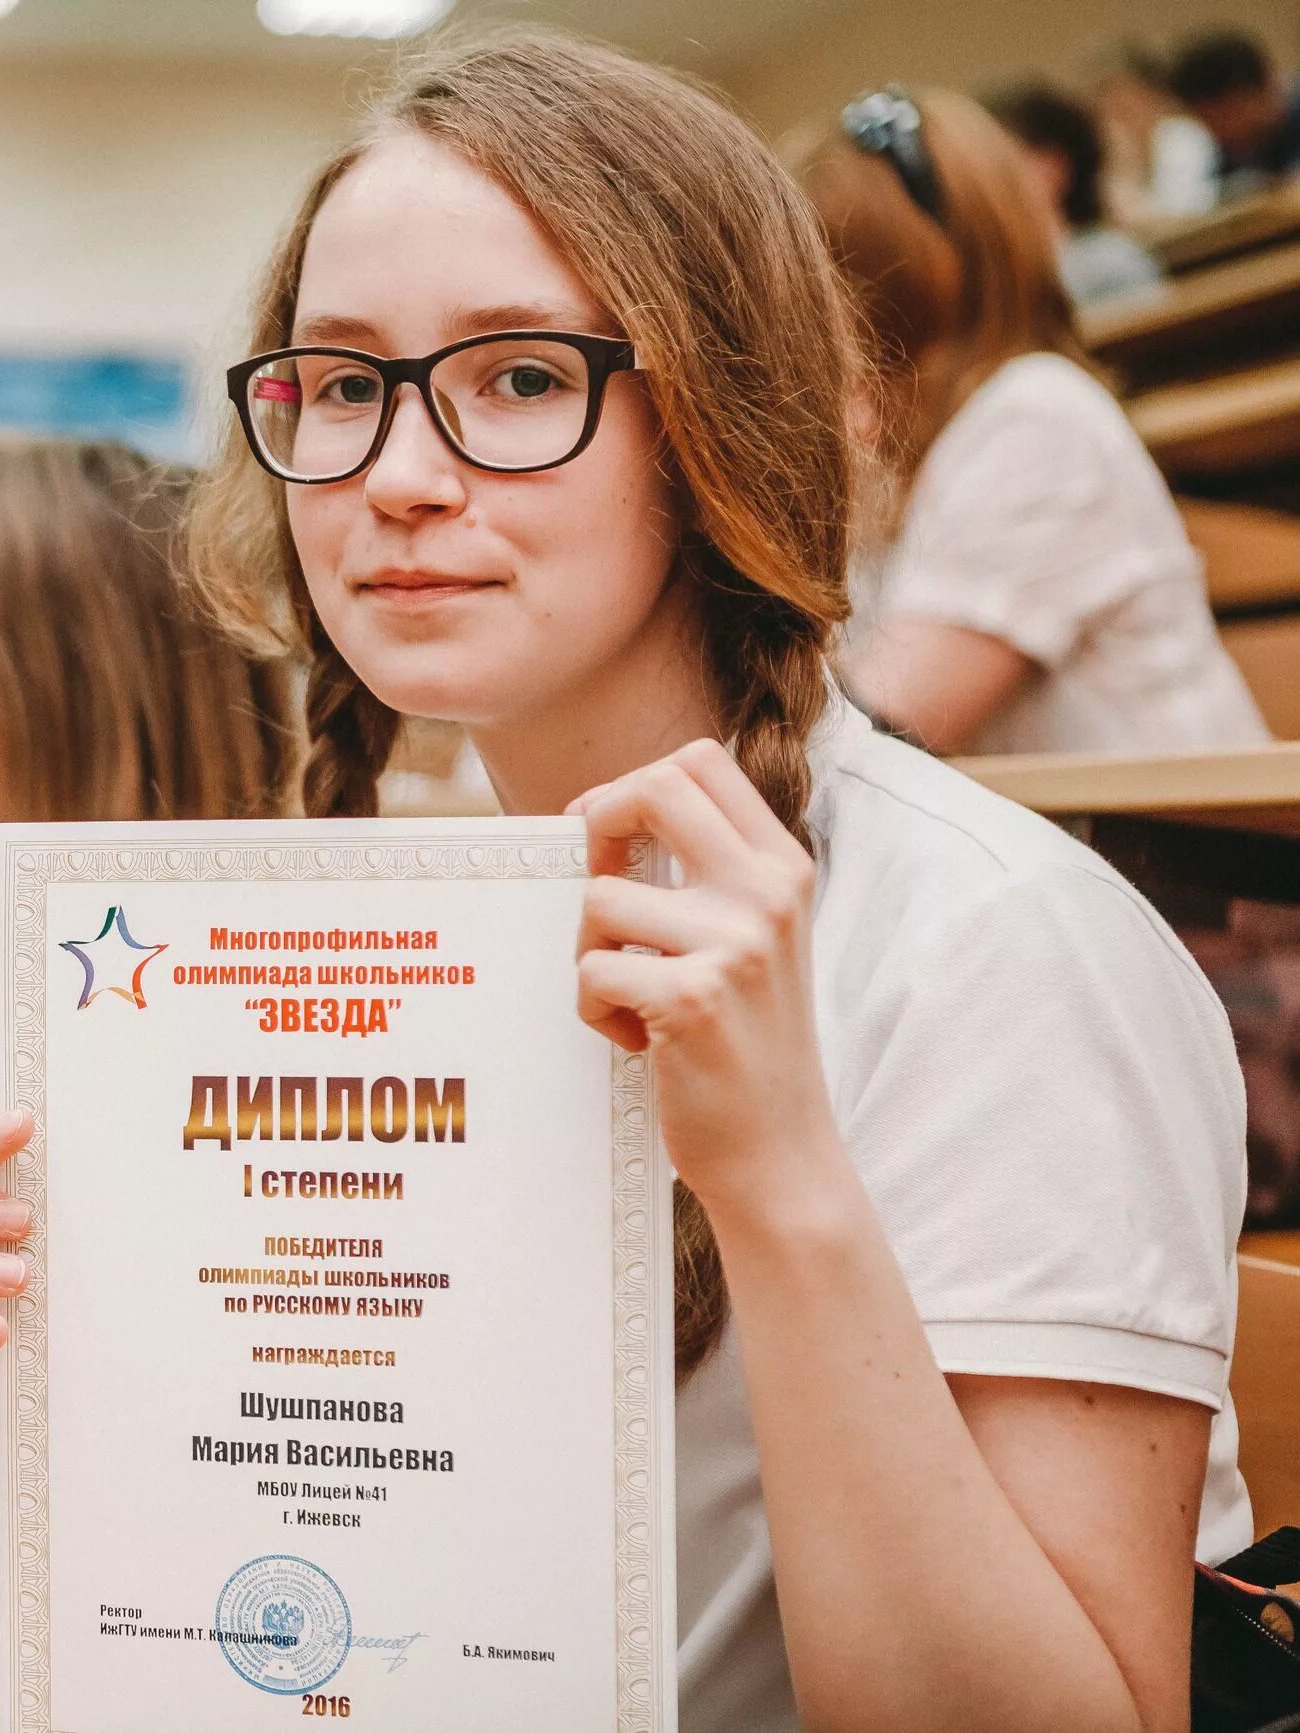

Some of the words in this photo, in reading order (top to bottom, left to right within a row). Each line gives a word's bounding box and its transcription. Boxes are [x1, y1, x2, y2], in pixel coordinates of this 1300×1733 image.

[210, 928, 437, 952] Многопрофильная
[173, 965, 312, 988] олимпиада
[318, 965, 476, 986] школьников
[183, 1076, 466, 1151] ДИПЛОМ
[244, 1164, 252, 1197] I
[261, 1170, 404, 1200] степени
[264, 1237, 383, 1259] ПОБЕДИТЕЛЯ
[199, 1267, 318, 1288] олимпиады
[324, 1270, 450, 1289] школьников
[224, 1297, 247, 1313] по
[253, 1294, 350, 1316] РУССКОМУ
[356, 1297, 423, 1318] ЯЗЫКУ
[252, 1346, 396, 1367] награждается
[240, 1392, 404, 1423] Шушпанова
[192, 1435, 279, 1465] Мария
[286, 1439, 454, 1472] Васильевна
[257, 1481, 297, 1497] МБОУ
[301, 1483, 351, 1501] Лицей
[356, 1485, 387, 1501] №41
[283, 1510, 293, 1524] г.
[297, 1509, 361, 1527] Ижевск
[100, 1604, 142, 1619] Ректор
[100, 1622, 137, 1637] ИжГТУ
[140, 1626, 181, 1639] имени
[184, 1628, 206, 1641] М.Т.
[209, 1629, 297, 1646] Калашникова
[463, 1644, 484, 1658] Б.А.
[488, 1646, 555, 1662] Якимович
[302, 1693, 351, 1719] 2016
